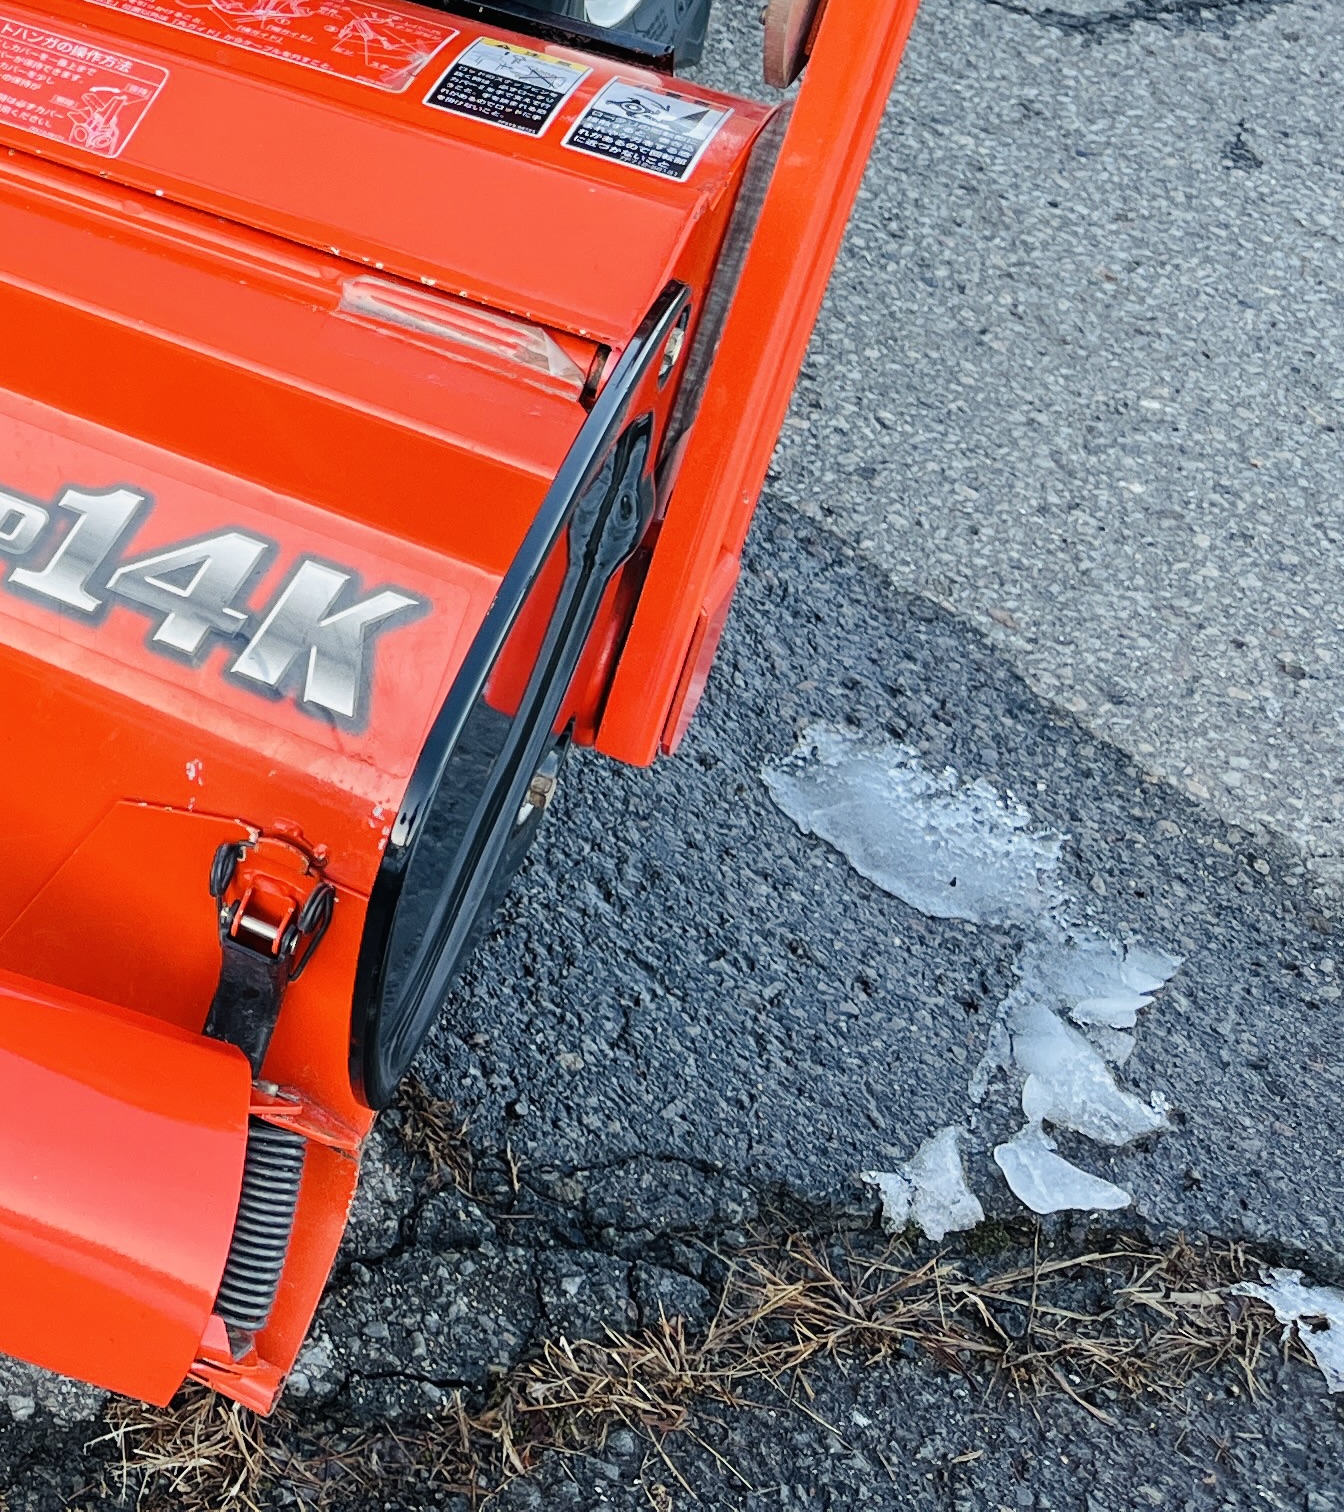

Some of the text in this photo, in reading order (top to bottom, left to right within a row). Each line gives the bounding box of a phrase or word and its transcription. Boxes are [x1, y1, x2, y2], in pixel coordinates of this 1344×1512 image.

[571, 134, 671, 169] に近づかないこと
[576, 127, 688, 165] れがあるので回転部
